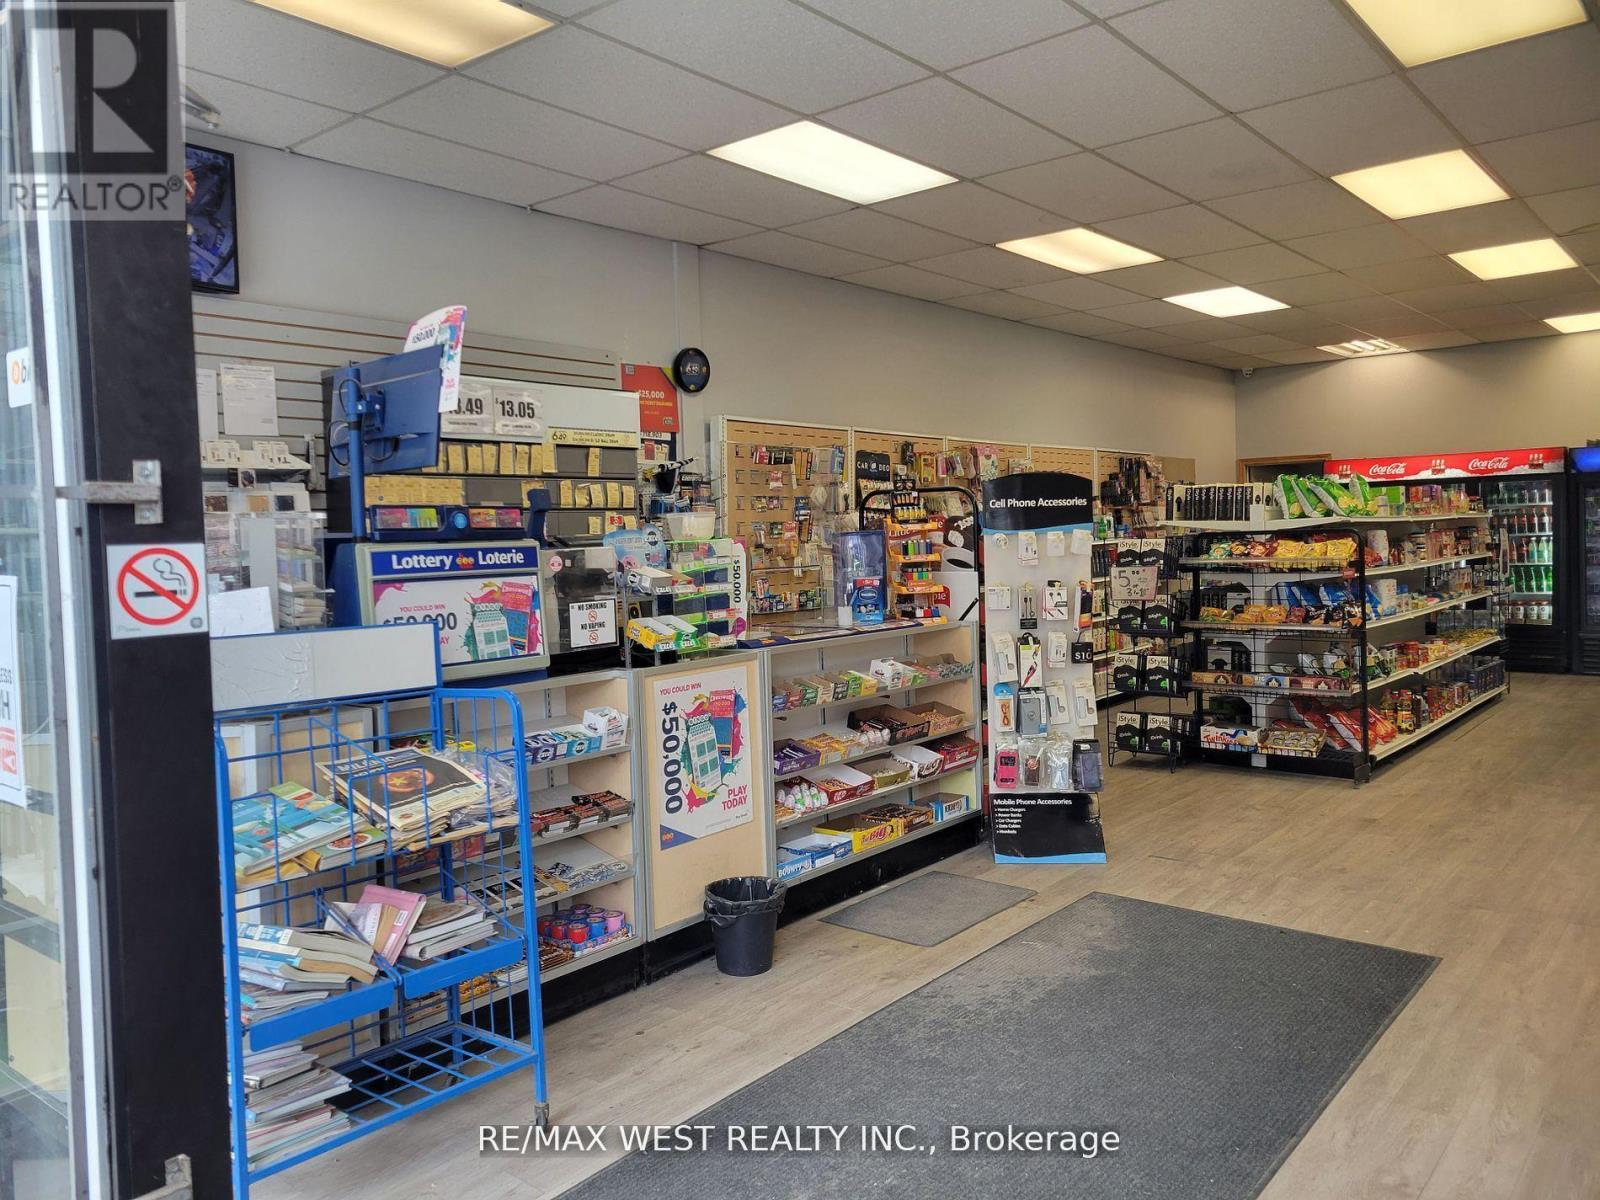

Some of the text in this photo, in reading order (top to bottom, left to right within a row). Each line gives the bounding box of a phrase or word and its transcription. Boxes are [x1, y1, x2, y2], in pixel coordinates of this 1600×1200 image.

[857, 461, 868, 470] CAR
[989, 497, 1087, 509] Cell Phone Accessories
[391, 554, 453, 570] Lottery
[478, 549, 524, 565] Loterie
[578, 602, 607, 611] NO SMOKING
[588, 621, 605, 629] VAPING
[660, 682, 702, 696] YOU COULD WIN
[662, 701, 683, 814] $50,000
[727, 784, 748, 799] PLAY
[722, 795, 748, 812] TODAY
[1037, 797, 1073, 805] Accessories
